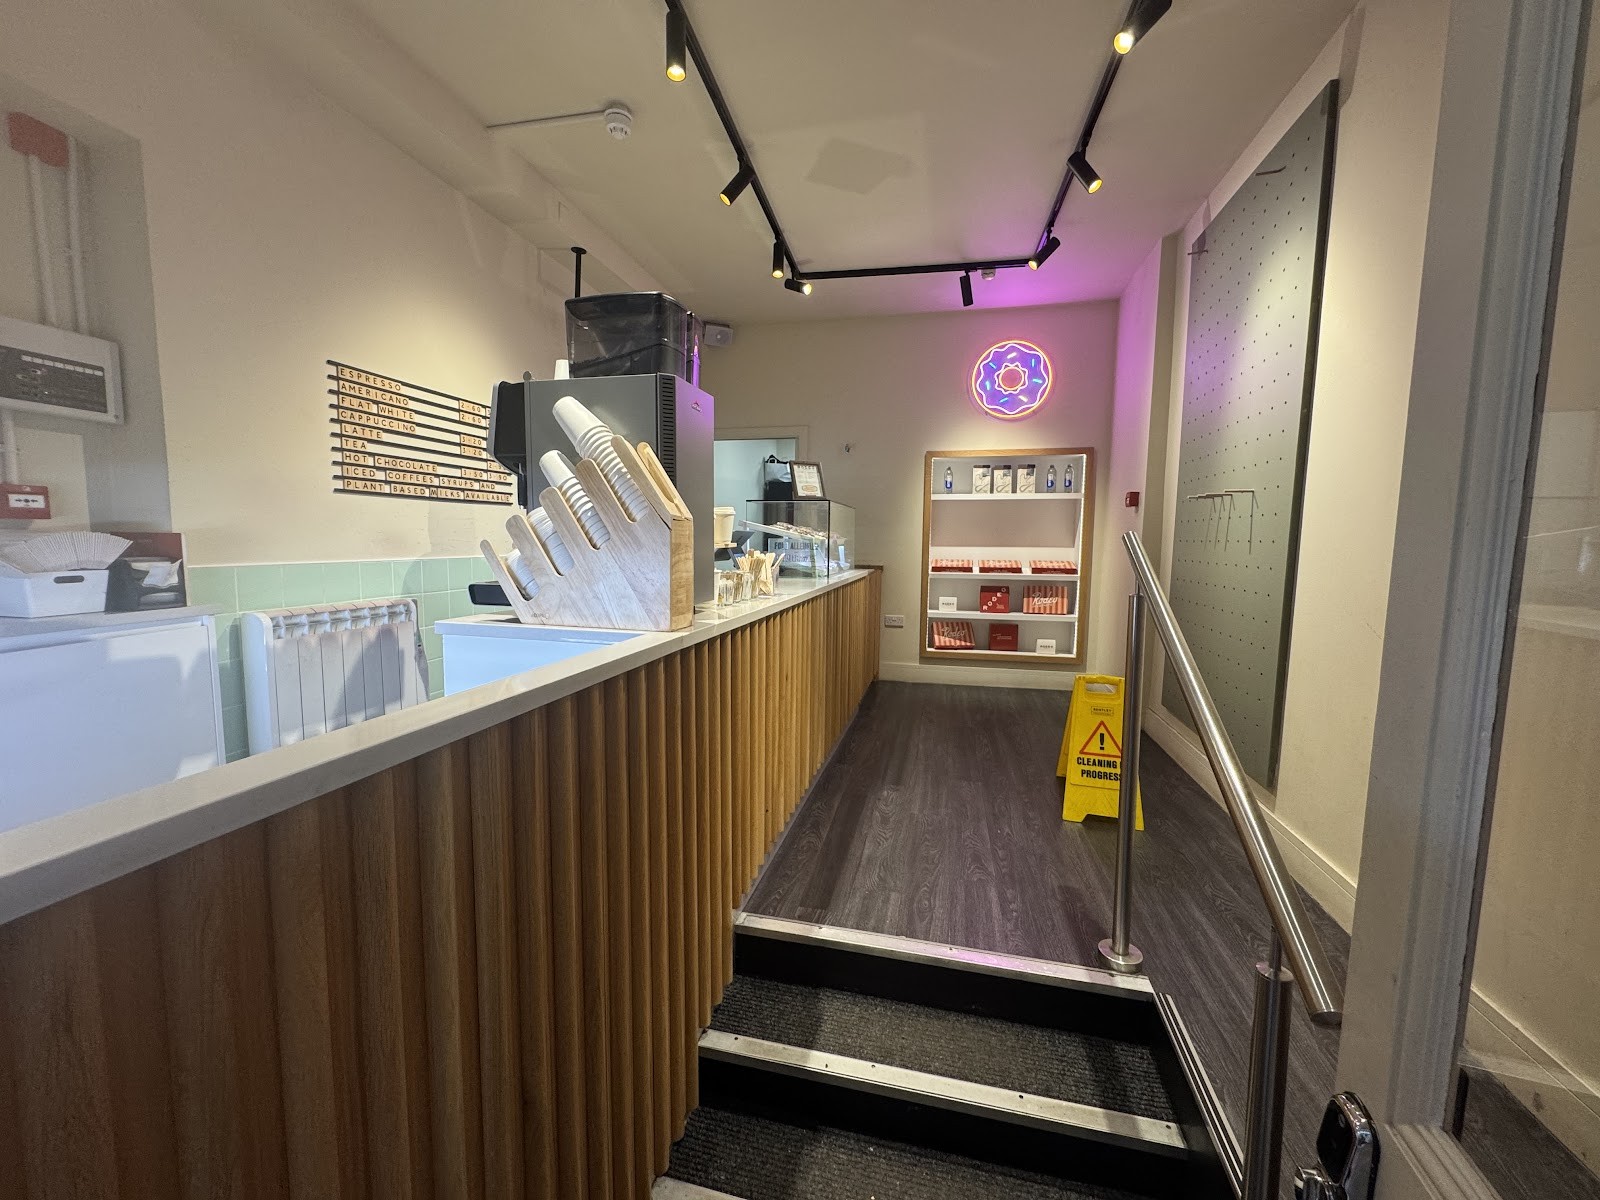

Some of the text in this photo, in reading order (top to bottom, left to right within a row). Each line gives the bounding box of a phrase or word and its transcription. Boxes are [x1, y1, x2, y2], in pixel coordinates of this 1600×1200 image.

[340, 368, 402, 392] ESPRESSO
[341, 383, 409, 406] AMERICANO
[341, 397, 414, 420] FLAT WHITE
[340, 411, 416, 432] CAPPUCCINO
[343, 425, 382, 439] LATTE
[344, 439, 367, 450] TEA
[345, 453, 368, 463] HOT
[376, 457, 437, 471] CHOCOLATE
[346, 467, 496, 490] ICED COFFEES SYRUPS AND
[346, 481, 510, 503] PLANT BASED MILKS AVAILABLE
[1076, 757, 1117, 768] CLEANING
